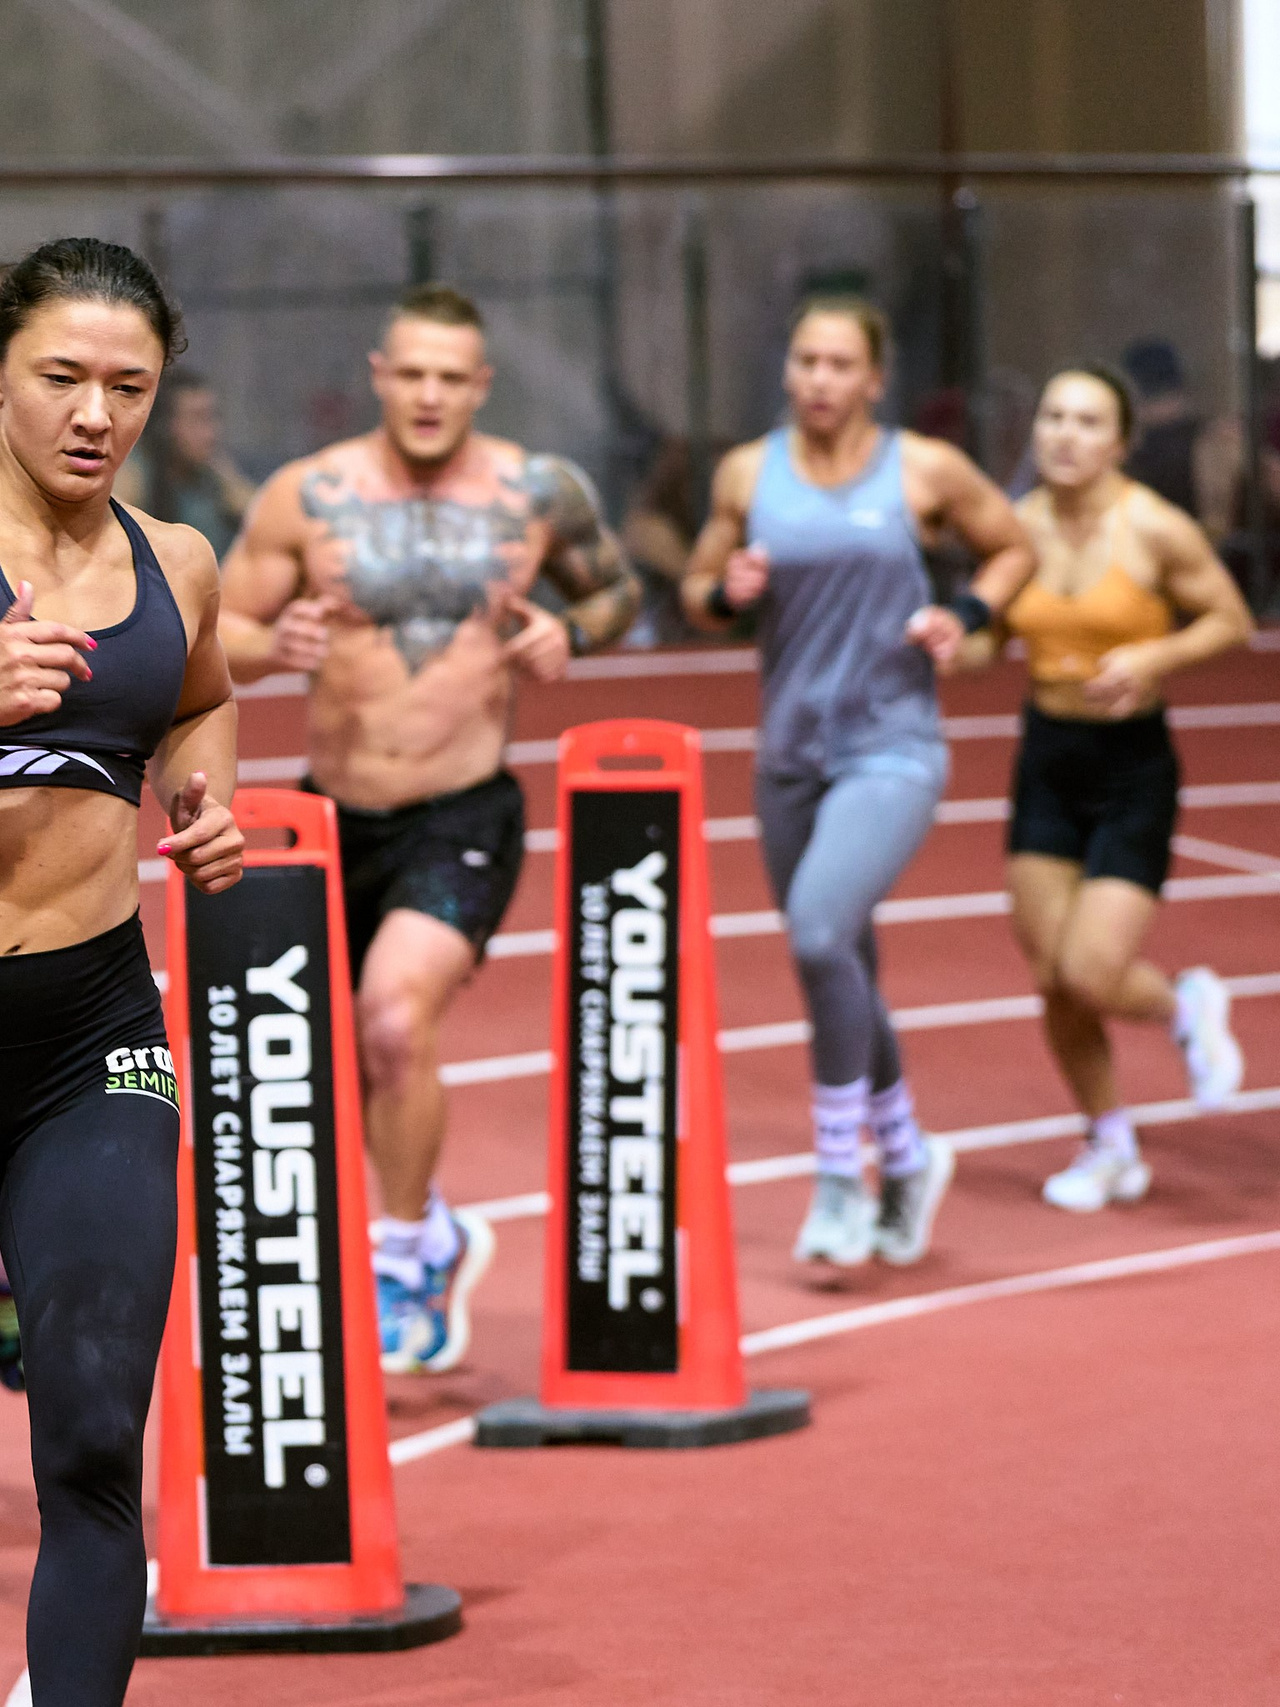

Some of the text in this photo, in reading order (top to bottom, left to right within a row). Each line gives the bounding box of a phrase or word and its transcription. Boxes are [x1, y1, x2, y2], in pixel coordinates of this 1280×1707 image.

[580, 883, 609, 922] 10
[580, 922, 609, 985] ЛЕТ
[105, 1046, 176, 1079] Cro
[105, 1071, 180, 1106] SEMIFI
[608, 851, 667, 1311] YOUSTEEL
[208, 984, 254, 1456] 10 ЛЕТ СНАРЯЖАЕМ ЗАЛЫ
[246, 945, 326, 1489] YOUSTEEL
[578, 1191, 606, 1282] ЗАЛЫ
